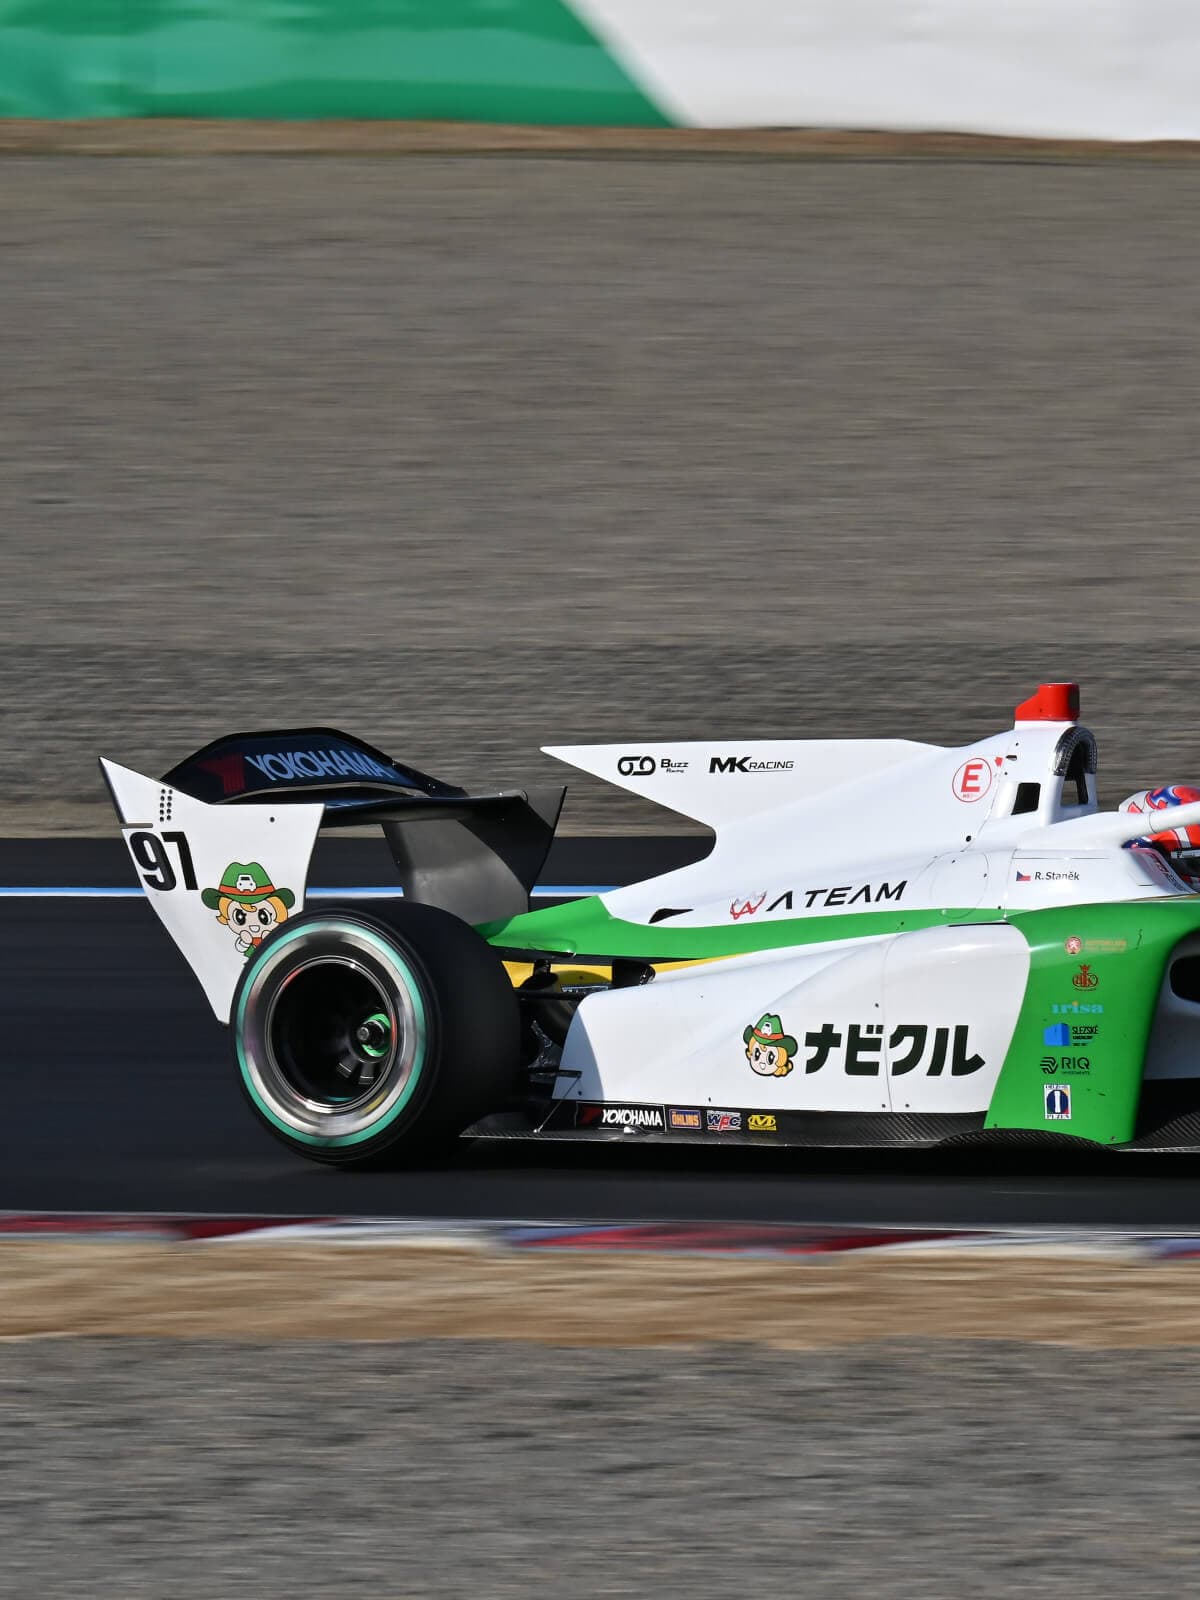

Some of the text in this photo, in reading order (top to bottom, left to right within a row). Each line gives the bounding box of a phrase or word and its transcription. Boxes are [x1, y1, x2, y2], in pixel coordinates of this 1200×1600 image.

[244, 750, 395, 781] YOKOHAMA
[709, 756, 795, 774] MK RACING
[960, 763, 984, 793] E
[129, 831, 200, 892] 97
[804, 880, 908, 909] TEAM
[804, 1023, 986, 1076] ナビクル
[1061, 1057, 1090, 1070] RIQ
[602, 1108, 663, 1127] YOKOHAMA
